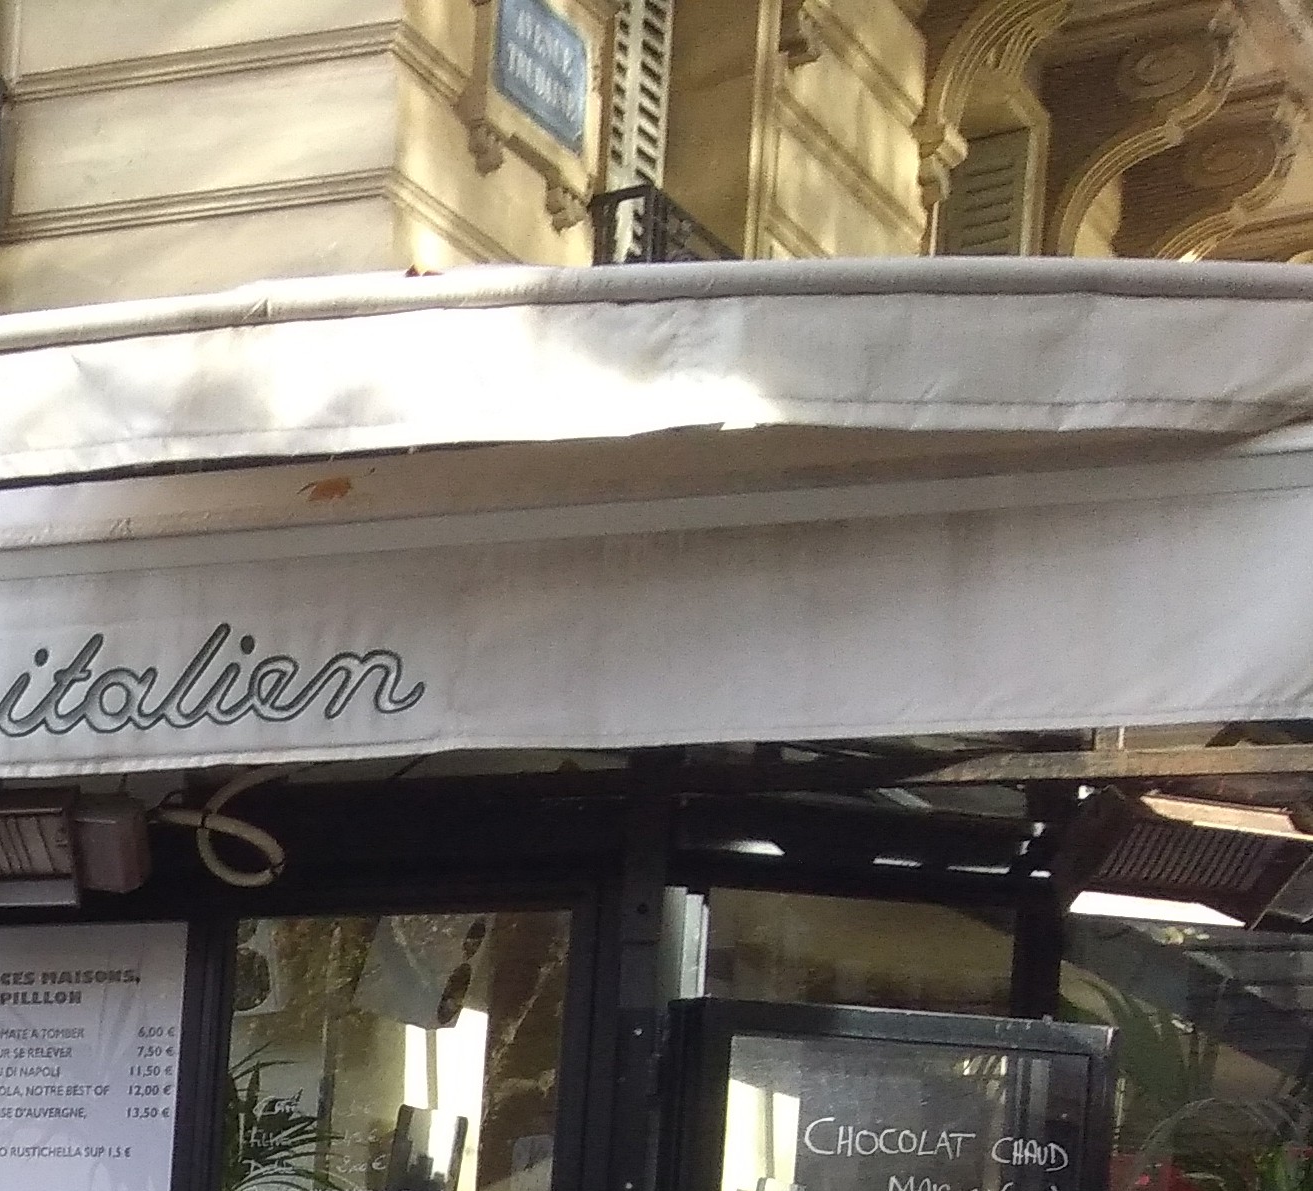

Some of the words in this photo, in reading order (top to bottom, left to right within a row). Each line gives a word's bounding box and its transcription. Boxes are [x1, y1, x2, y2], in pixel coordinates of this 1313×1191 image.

[41, 970, 140, 985] MAISONS,
[804, 1117, 976, 1159] CHOCOLAT
[991, 1137, 1068, 1172] CHAUD
